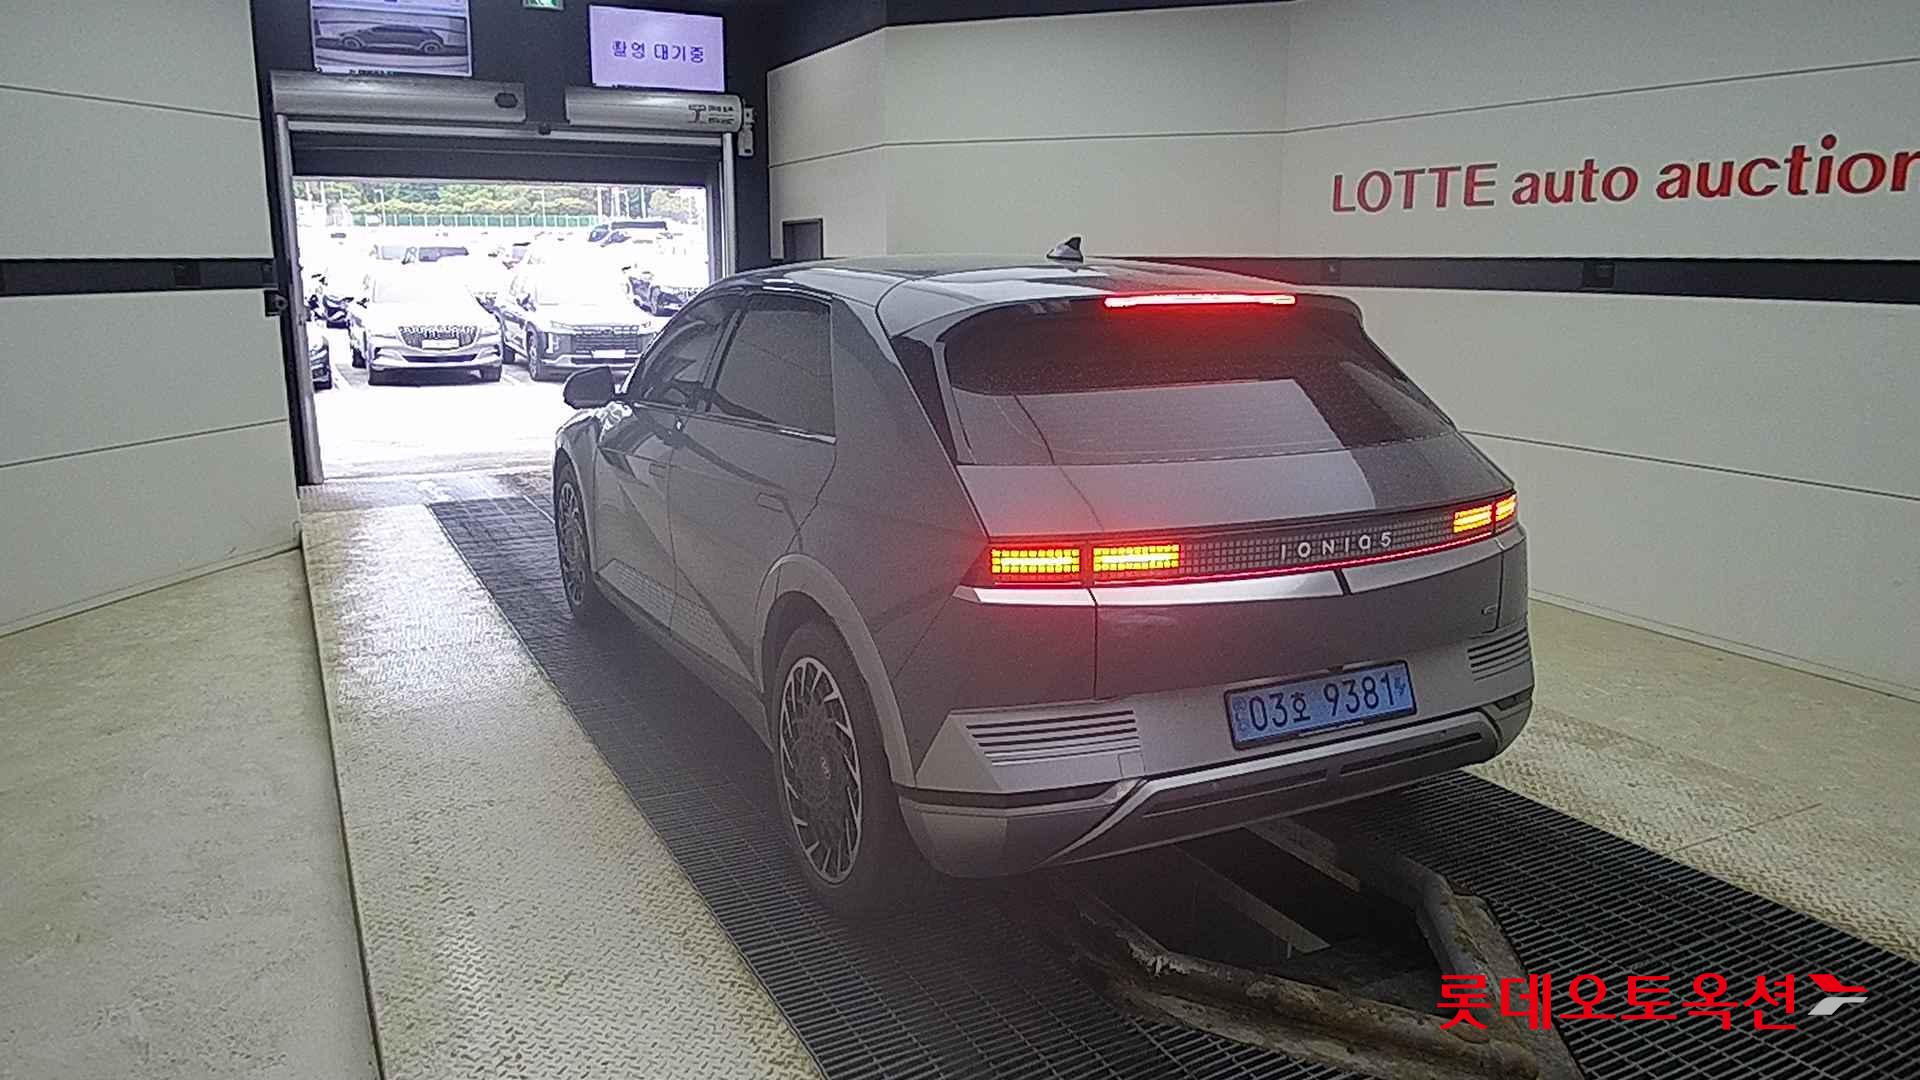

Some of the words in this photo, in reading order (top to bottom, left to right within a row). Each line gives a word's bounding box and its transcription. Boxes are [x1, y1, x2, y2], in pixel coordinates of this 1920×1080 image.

[613, 40, 646, 59] 촬영
[653, 43, 704, 63] 대기중
[1332, 163, 1498, 213] LOTTE
[1512, 159, 1638, 206] auto
[1250, 691, 1311, 731] 03호
[1322, 671, 1395, 716] 9381
